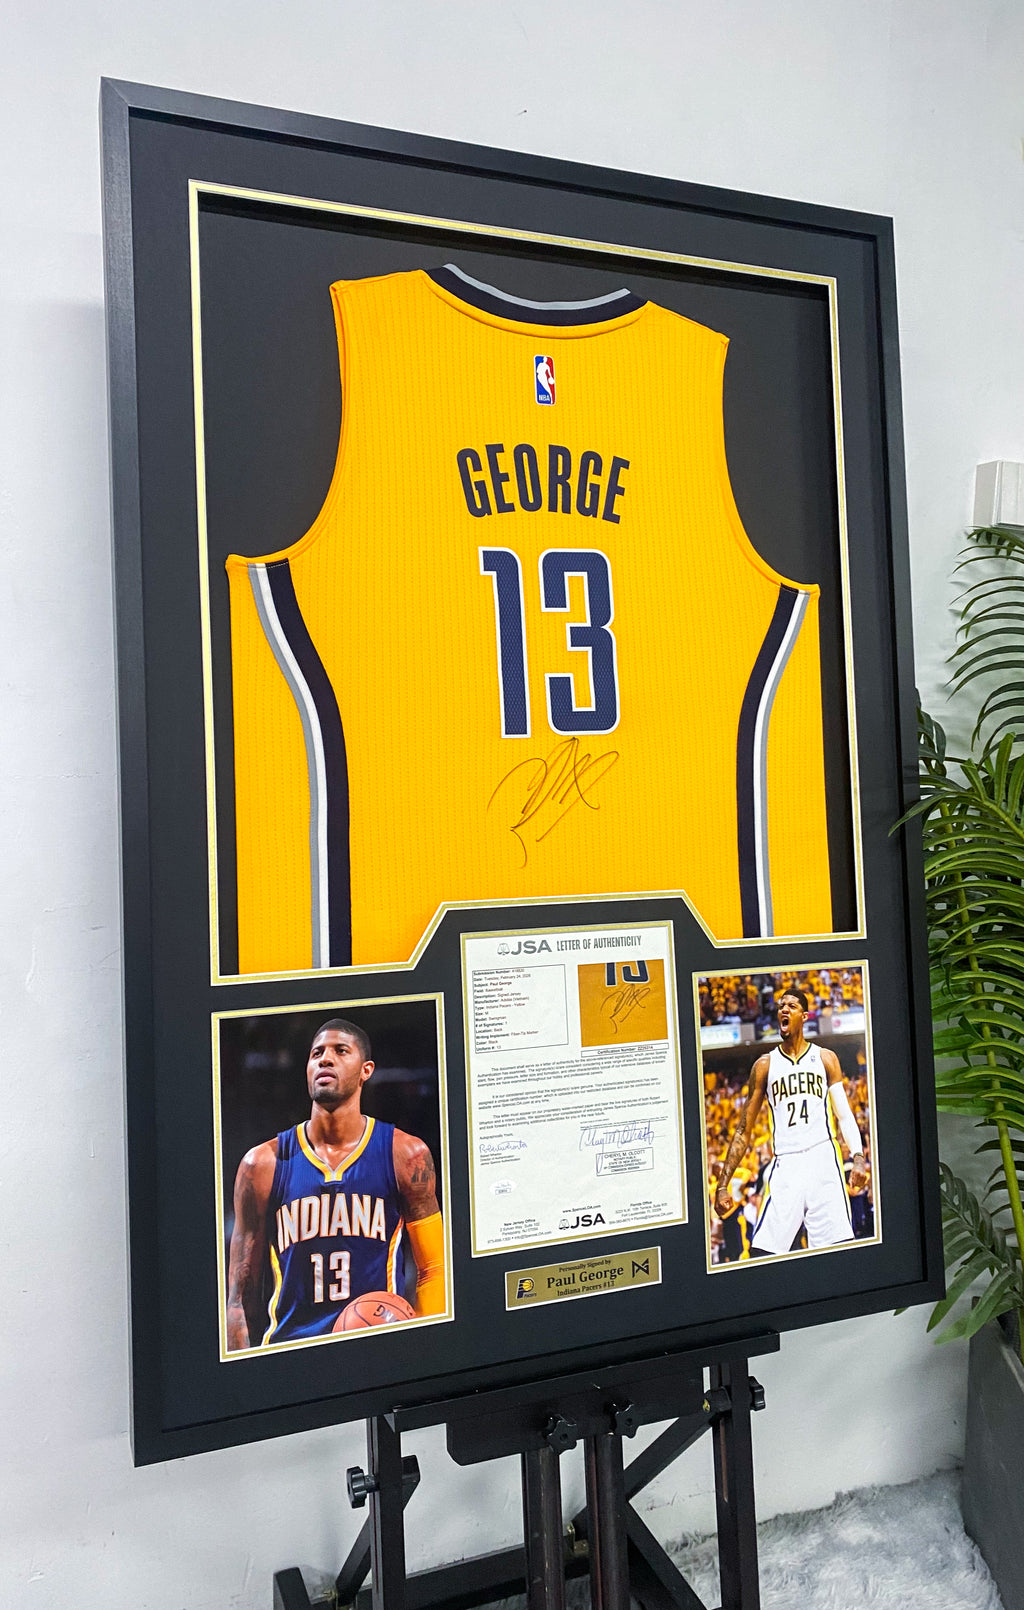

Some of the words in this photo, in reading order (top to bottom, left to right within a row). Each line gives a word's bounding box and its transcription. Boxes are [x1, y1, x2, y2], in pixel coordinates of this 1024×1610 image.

[456, 443, 630, 524] GEORGE
[478, 546, 620, 738] 13
[510, 939, 552, 956] JSA
[556, 939, 580, 952] LETTER
[582, 938, 592, 949] OF
[593, 935, 642, 949] AUTHENTICITY
[771, 1072, 823, 1106] PACERS
[787, 1099, 809, 1128] 24
[276, 1193, 386, 1254] INDIANA
[570, 1213, 606, 1229] JSA
[310, 1251, 351, 1304] 13
[547, 1273, 576, 1288] Paul
[579, 1267, 624, 1283] George
[559, 1262, 586, 1272] Personally
[587, 1260, 603, 1269] Signed
[557, 1287, 581, 1297] Indiana
[582, 1284, 602, 1293] Pacers
[603, 1281, 615, 1289] #13
